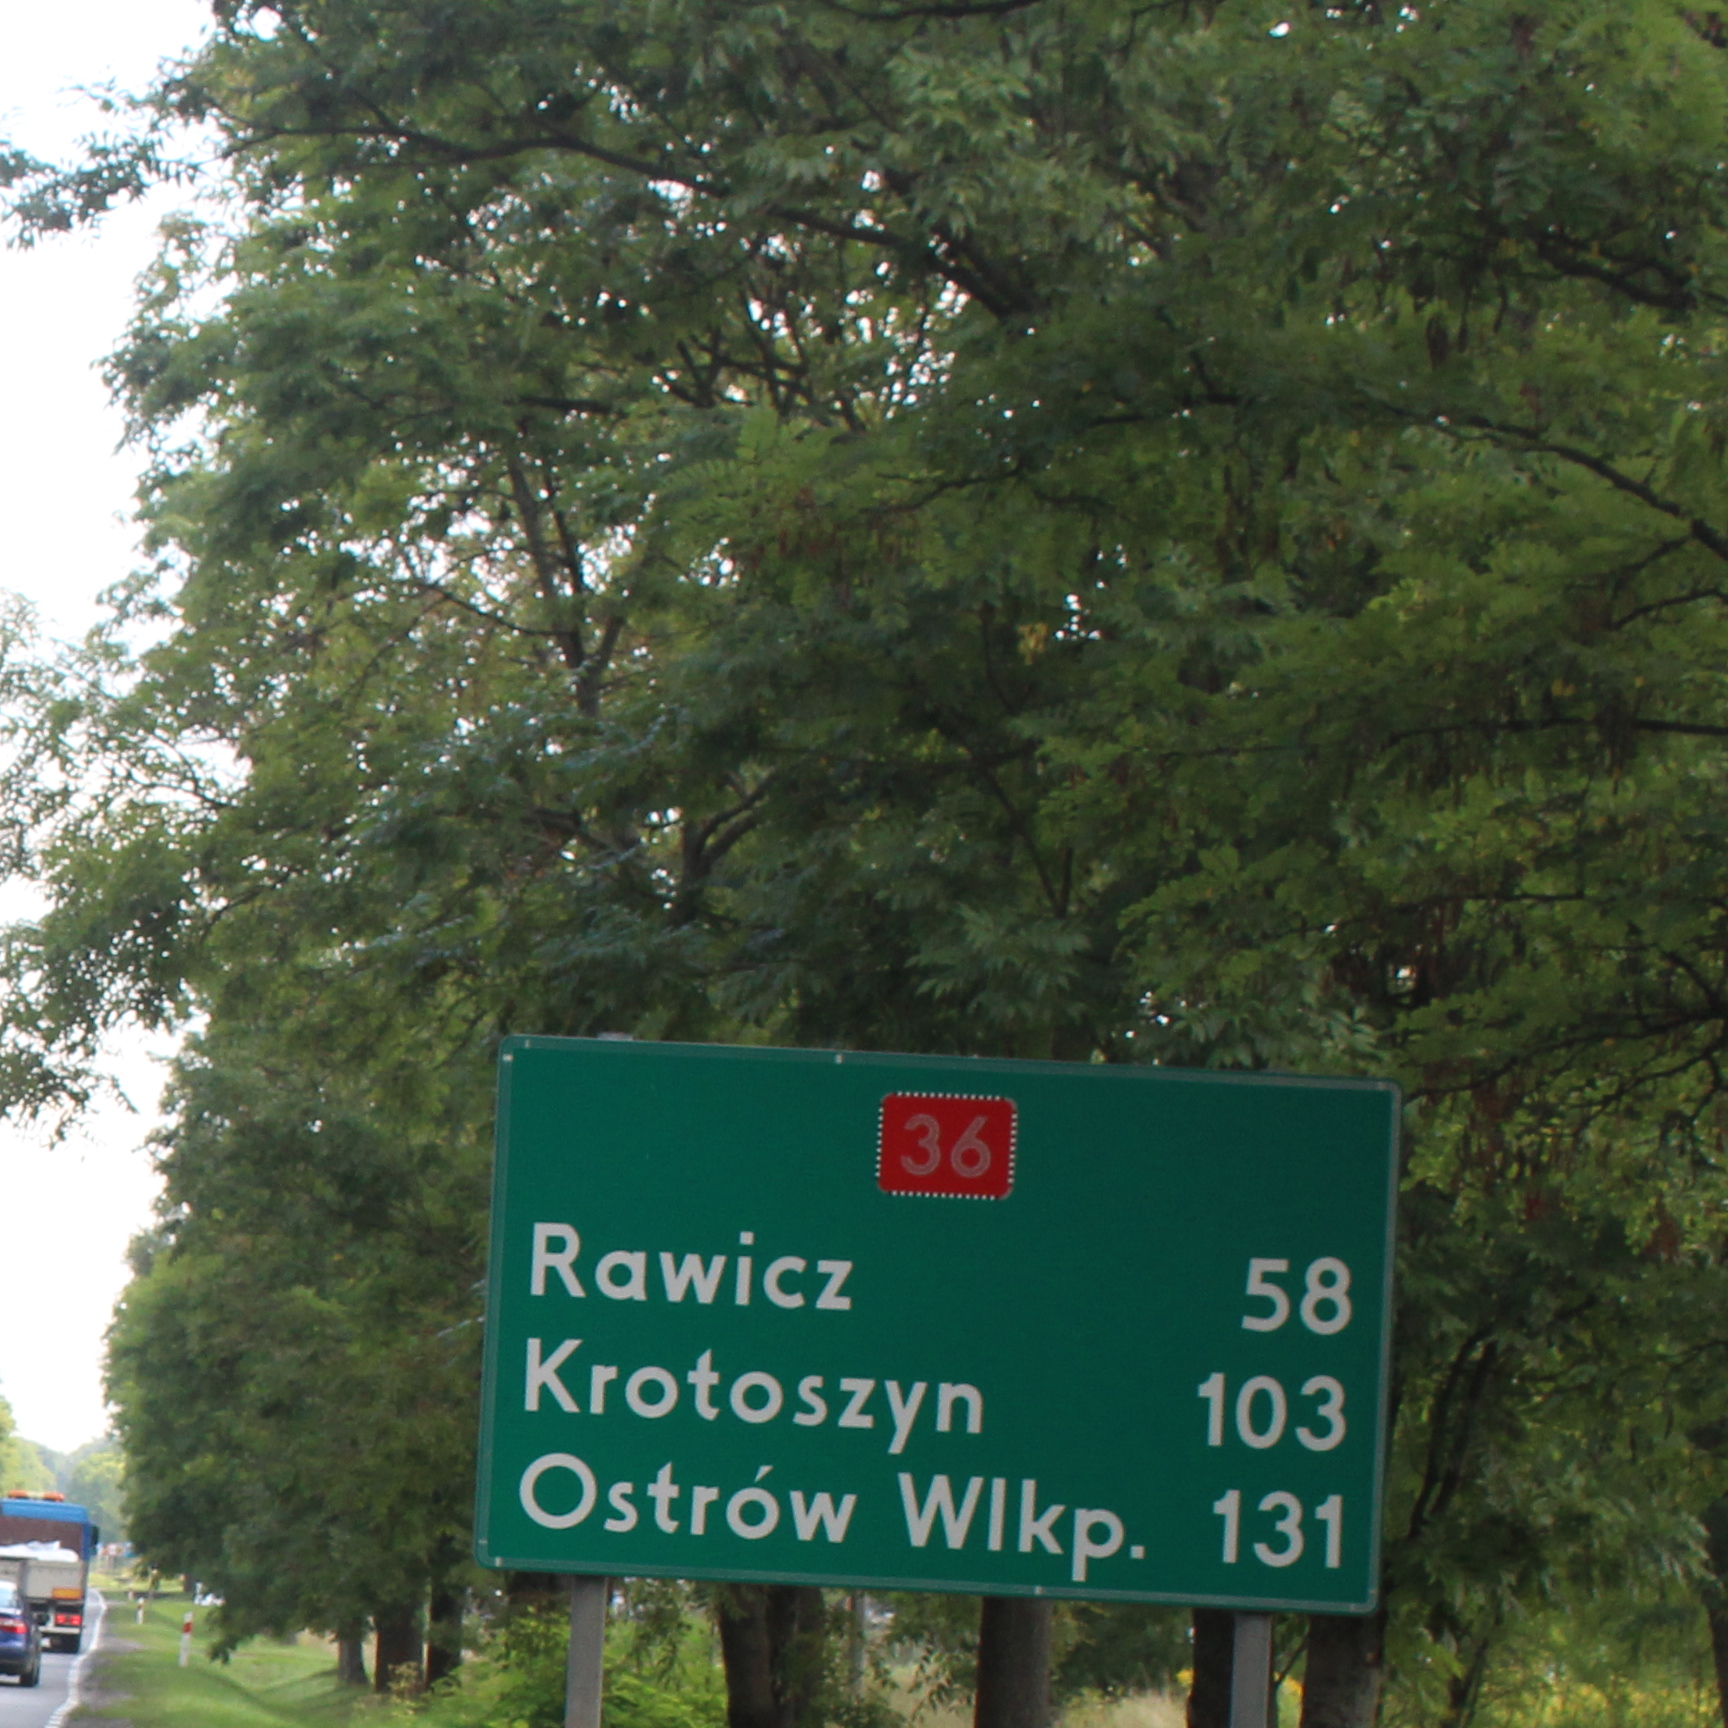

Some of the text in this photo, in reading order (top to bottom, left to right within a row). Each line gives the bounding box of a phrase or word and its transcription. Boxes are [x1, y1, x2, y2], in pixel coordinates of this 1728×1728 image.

[899, 1112, 992, 1179] 36
[530, 1222, 1352, 1335] Rawicz 58
[524, 1337, 1346, 1454] Krotoszyn 103
[519, 1452, 1343, 1582] Ostrów Wlkp. 131
